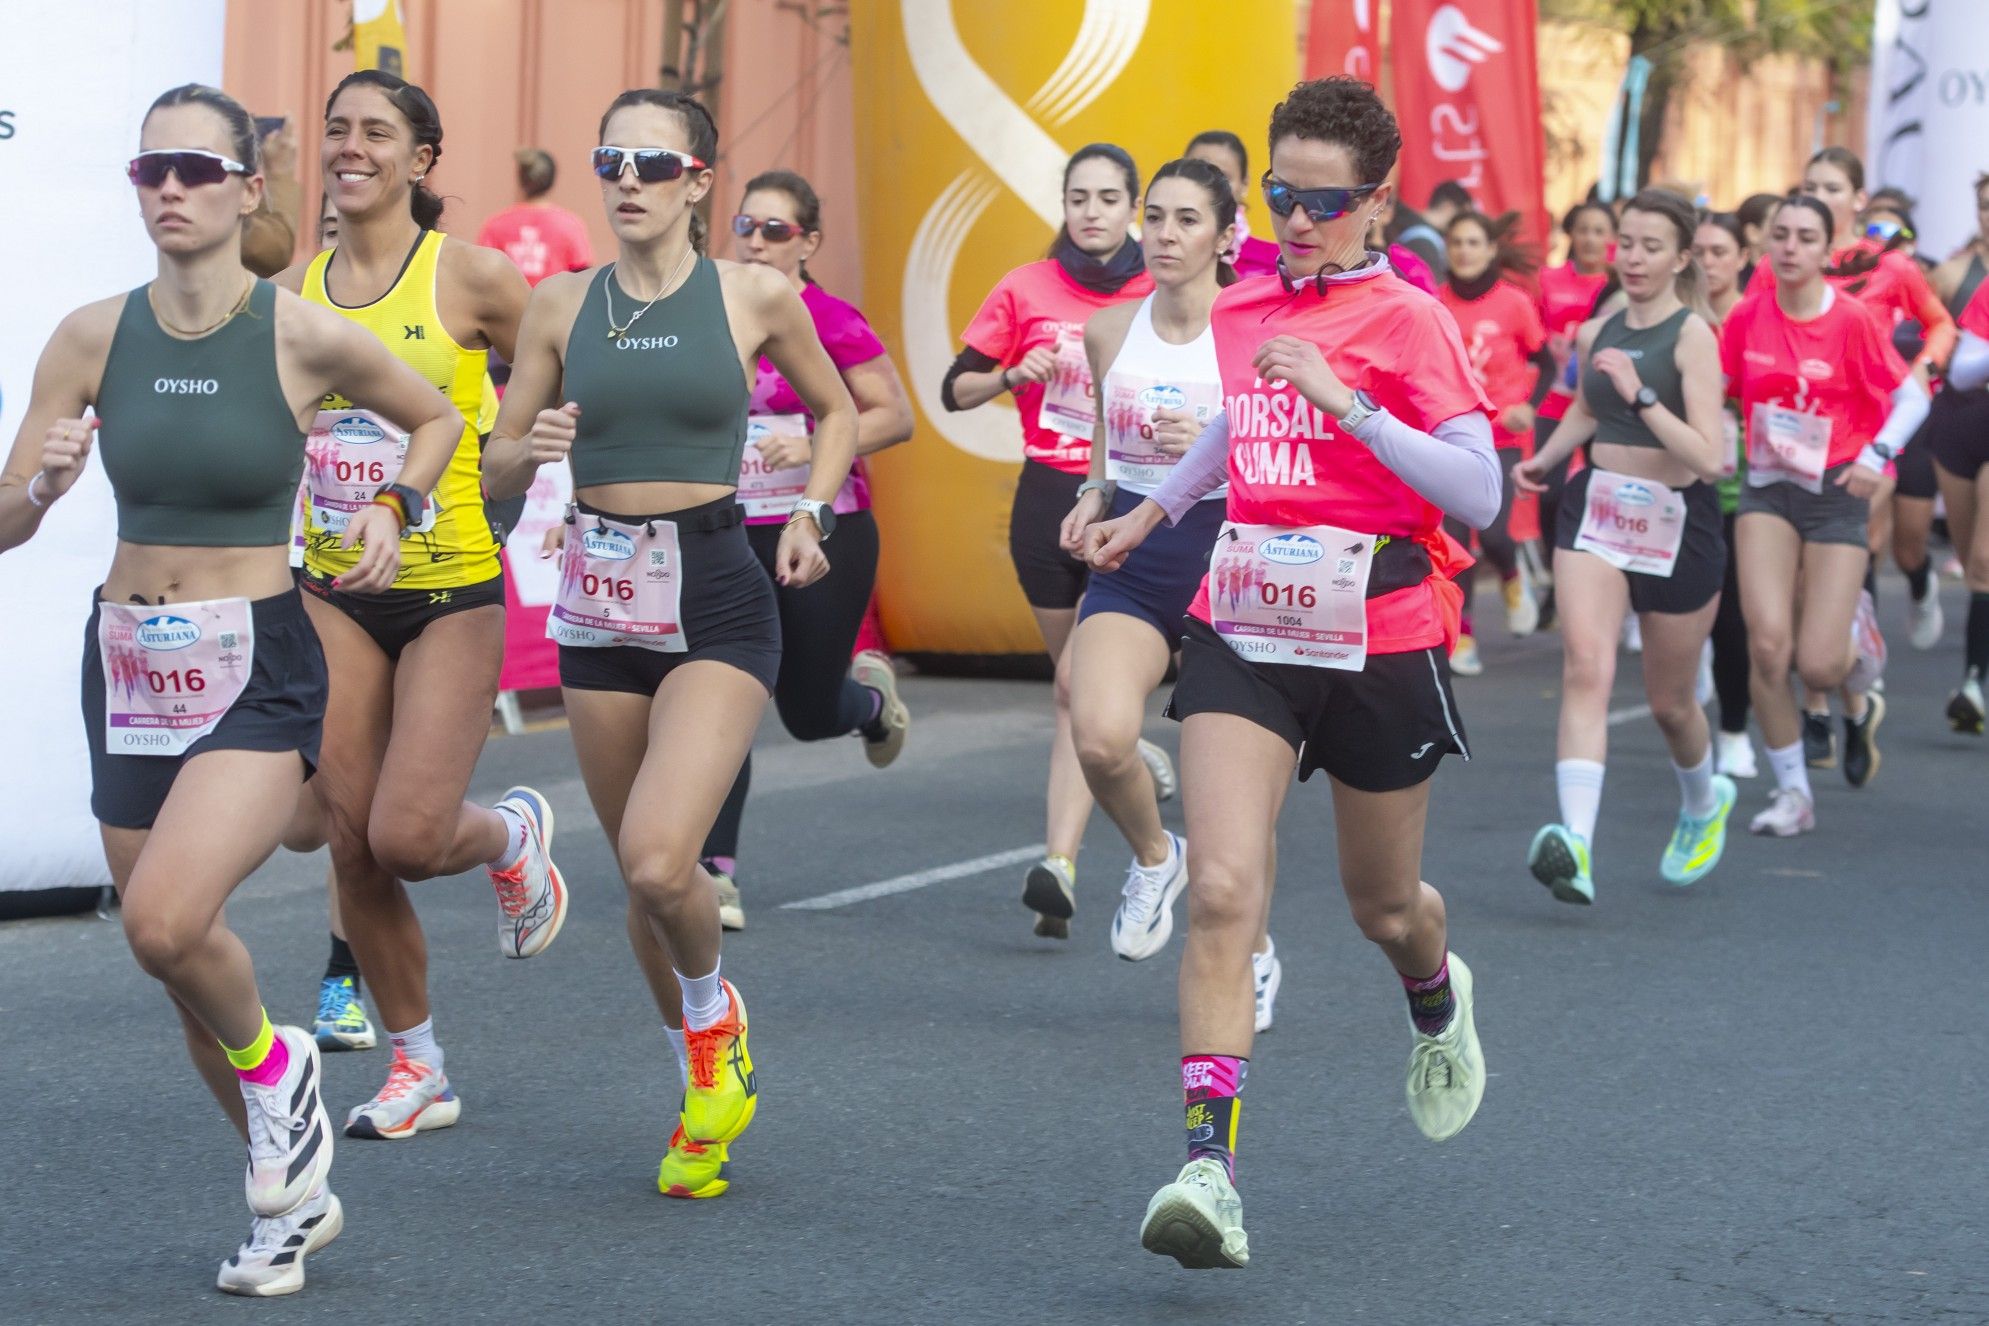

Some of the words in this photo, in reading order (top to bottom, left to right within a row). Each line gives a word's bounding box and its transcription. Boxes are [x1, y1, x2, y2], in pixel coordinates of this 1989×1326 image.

[616, 335, 678, 350] OYSHO
[154, 378, 219, 395] OYSHO
[741, 457, 774, 475] 016
[1235, 441, 1316, 486] SUMA
[336, 461, 385, 482] 016
[354, 491, 366, 501] 24
[1615, 515, 1648, 534] 016
[584, 535, 632, 556] ASTURIANA
[1263, 543, 1320, 558] ASTURIANA
[582, 574, 634, 601] 016
[1261, 582, 1317, 609] 016
[603, 608, 610, 618] 5
[1276, 615, 1303, 627] 1004
[557, 626, 596, 641] OYSHO
[631, 624, 660, 633] SEVILLA
[1266, 627, 1276, 635] DE
[1276, 628, 1287, 636] LA
[1315, 632, 1344, 641] SEVILLA
[109, 631, 133, 641] SUMA
[140, 629, 196, 643] ASTURIANA
[1229, 640, 1277, 654] OYSHO
[1305, 648, 1350, 660] Santander
[148, 668, 206, 694] 016
[172, 704, 187, 714] 44
[129, 716, 159, 726] CARRERA
[123, 733, 170, 746] OYSHO
